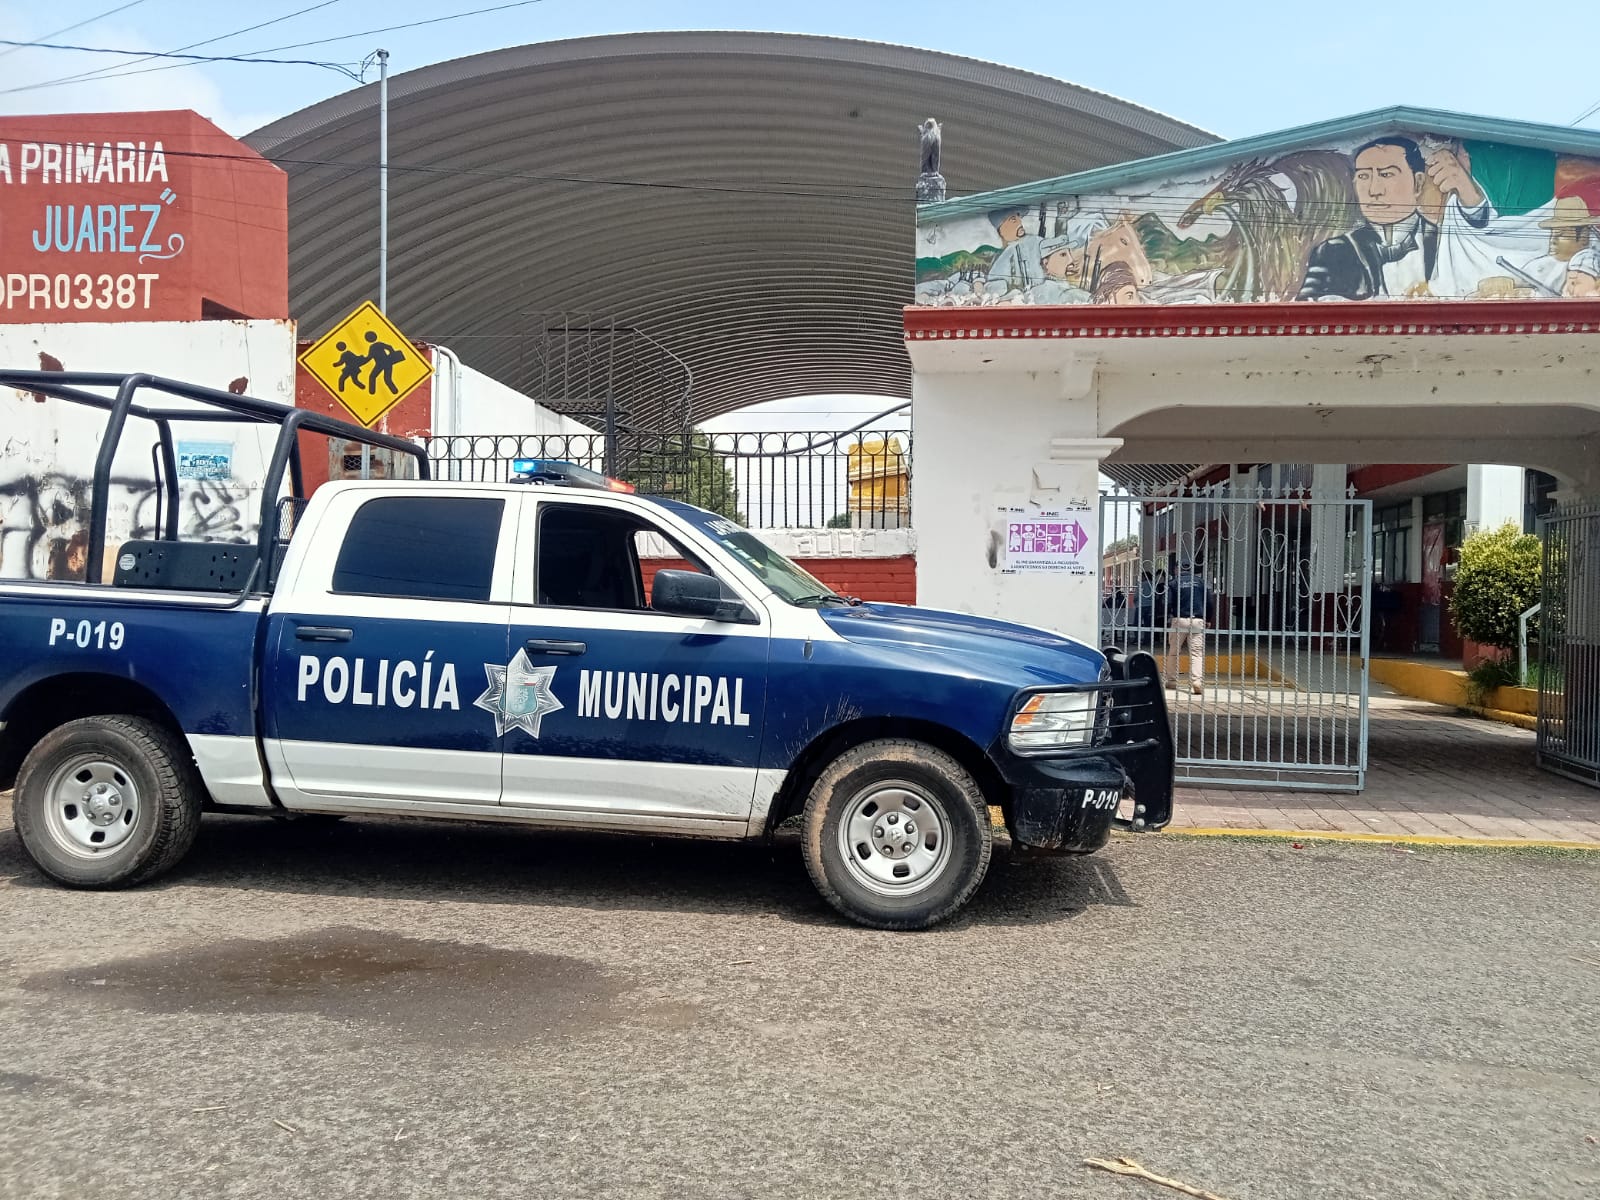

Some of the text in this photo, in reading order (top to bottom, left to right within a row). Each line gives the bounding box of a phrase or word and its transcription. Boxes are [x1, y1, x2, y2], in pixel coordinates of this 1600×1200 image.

[20, 141, 169, 184] PRIMARIA
[0, 273, 159, 309] PR0338T
[49, 618, 125, 650] P-019
[297, 650, 750, 727] POLICÍA MUNICIPAL
[1081, 789, 1119, 810] P-019
